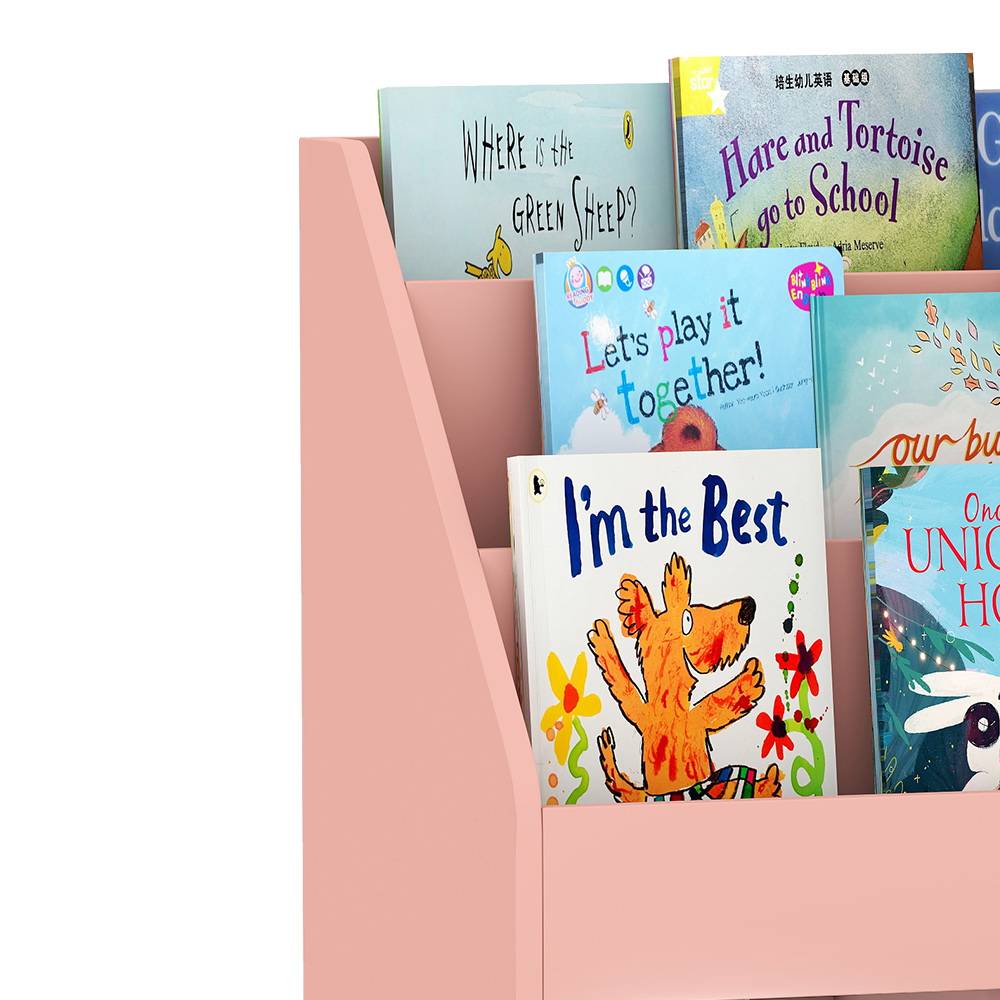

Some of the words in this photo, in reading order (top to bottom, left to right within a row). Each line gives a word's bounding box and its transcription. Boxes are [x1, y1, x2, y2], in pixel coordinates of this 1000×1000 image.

[775, 72, 833, 90] 培生幼儿英语
[462, 116, 527, 184] WHERE
[719, 135, 789, 202] Hare
[794, 116, 834, 157] and
[838, 99, 949, 182] Tortoise
[512, 193, 565, 236] GREEN
[571, 175, 637, 252] SHEEP?
[757, 204, 780, 248] go
[784, 189, 805, 221] to
[809, 161, 900, 223] School
[854, 239, 884, 251] Meserve
[581, 326, 649, 374] Let's
[658, 310, 712, 362] play
[719, 289, 742, 329] it
[617, 341, 765, 425] together!
[864, 433, 958, 467] our
[564, 476, 634, 578] I'm
[640, 486, 692, 543] the
[701, 474, 789, 558] Best
